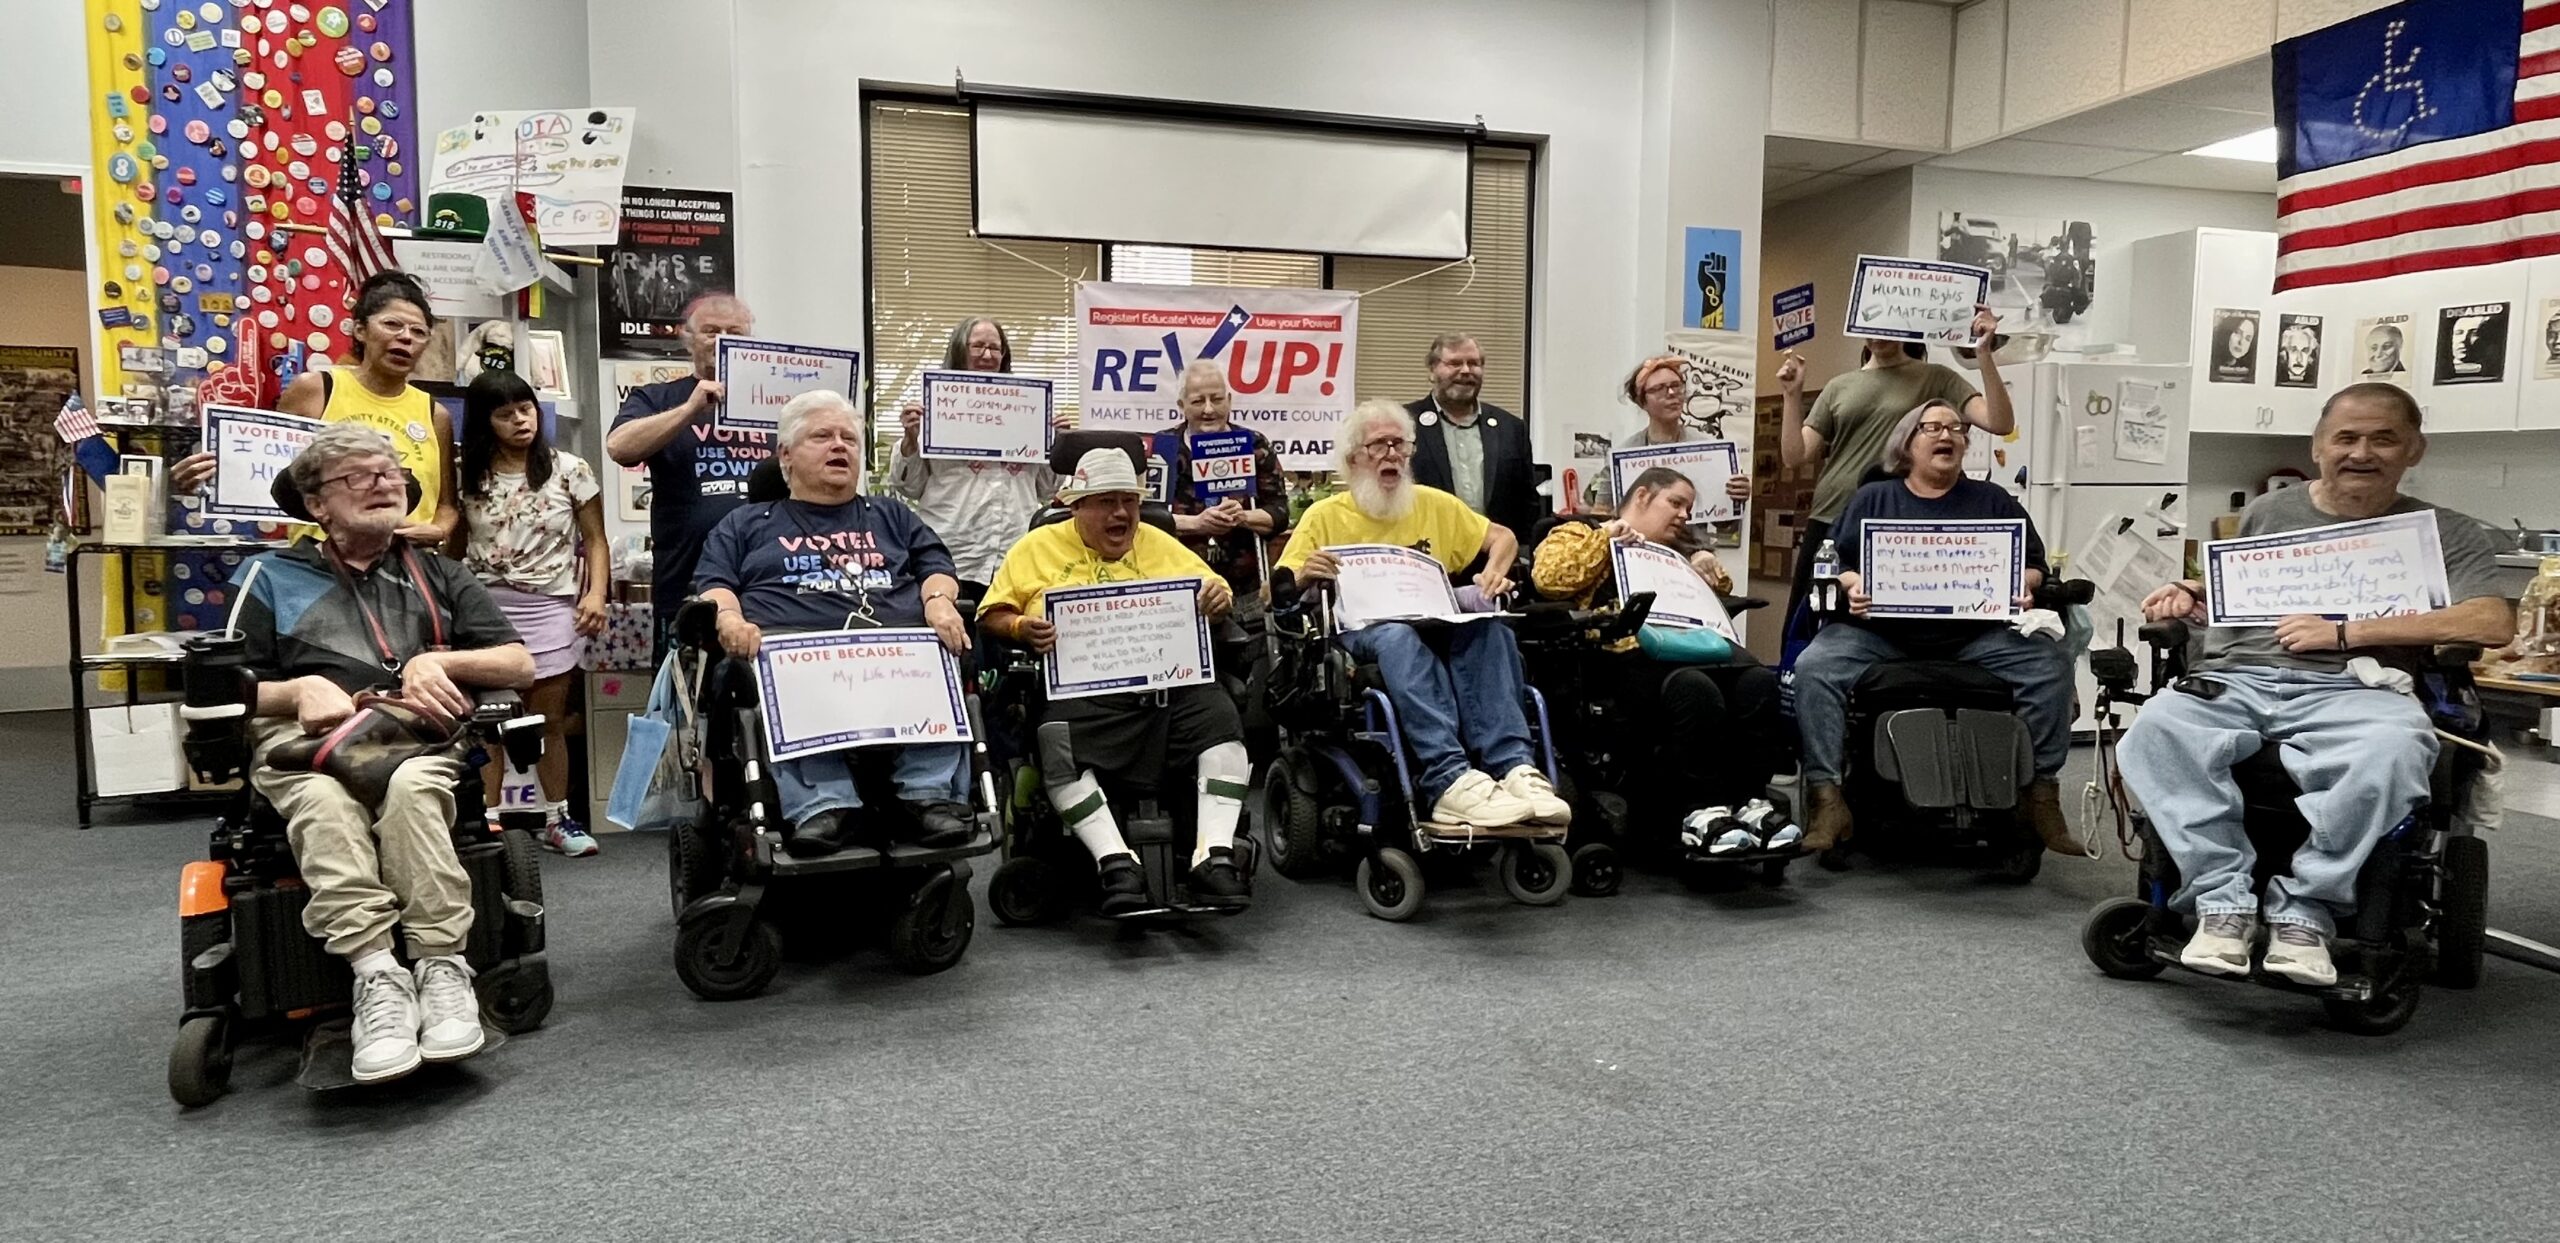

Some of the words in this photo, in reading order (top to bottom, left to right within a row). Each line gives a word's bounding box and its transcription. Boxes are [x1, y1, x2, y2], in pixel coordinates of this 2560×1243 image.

[645, 198, 676, 208] LONGER
[678, 200, 720, 210] ACCEPTING
[626, 209, 654, 219] THINGS
[656, 210, 660, 219] I
[661, 211, 692, 221] CANNOT
[694, 212, 726, 223] CHANGE
[1876, 270, 1902, 279] VOTE
[1872, 283, 1921, 296] Human
[1888, 305, 1947, 322] MATTER
[2446, 304, 2503, 318] DISABLED
[1092, 312, 1140, 325] Register!
[1142, 313, 1188, 325] Educate!
[1189, 315, 1217, 326] Vote!
[1256, 318, 1277, 328] Use
[1278, 320, 1301, 330] your
[1302, 318, 1337, 329] Power!
[1776, 308, 1811, 331] VOTE
[620, 321, 651, 335] IDLE
[734, 351, 737, 359] I
[741, 352, 771, 363] VOTE
[770, 366, 776, 376] I
[942, 385, 970, 394] VOTE
[937, 397, 957, 408] MY
[967, 399, 1037, 415] COMMUNITY
[1091, 408, 1132, 420] MAKE
[1137, 408, 1164, 420] THE
[1251, 410, 1288, 421] VOTE
[1291, 410, 1343, 422] COUNT
[228, 425, 232, 434] I
[238, 425, 279, 439] VOTE
[696, 446, 726, 459] USE
[1196, 458, 1251, 478] VOTE
[1631, 459, 1658, 468] VOTE
[778, 531, 876, 552] VOTE!
[1878, 536, 1881, 544] I
[1885, 536, 1916, 545] VOTE
[1347, 557, 1377, 566] VOTE
[2230, 555, 2233, 563] I
[2239, 550, 2284, 562] VOTE
[783, 555, 822, 572] USE
[1900, 563, 1947, 573] Issues
[2279, 567, 2303, 579] my
[2308, 556, 2354, 577] duty
[2368, 548, 2404, 565] and
[1060, 606, 1063, 615] I
[1067, 602, 1100, 614] VOTE
[779, 654, 783, 665] I
[788, 651, 831, 664] VOTE
[1093, 652, 1116, 660] WILL
[1092, 660, 1122, 672] RIGHT
[833, 670, 853, 691] My
[864, 668, 885, 682] Life
